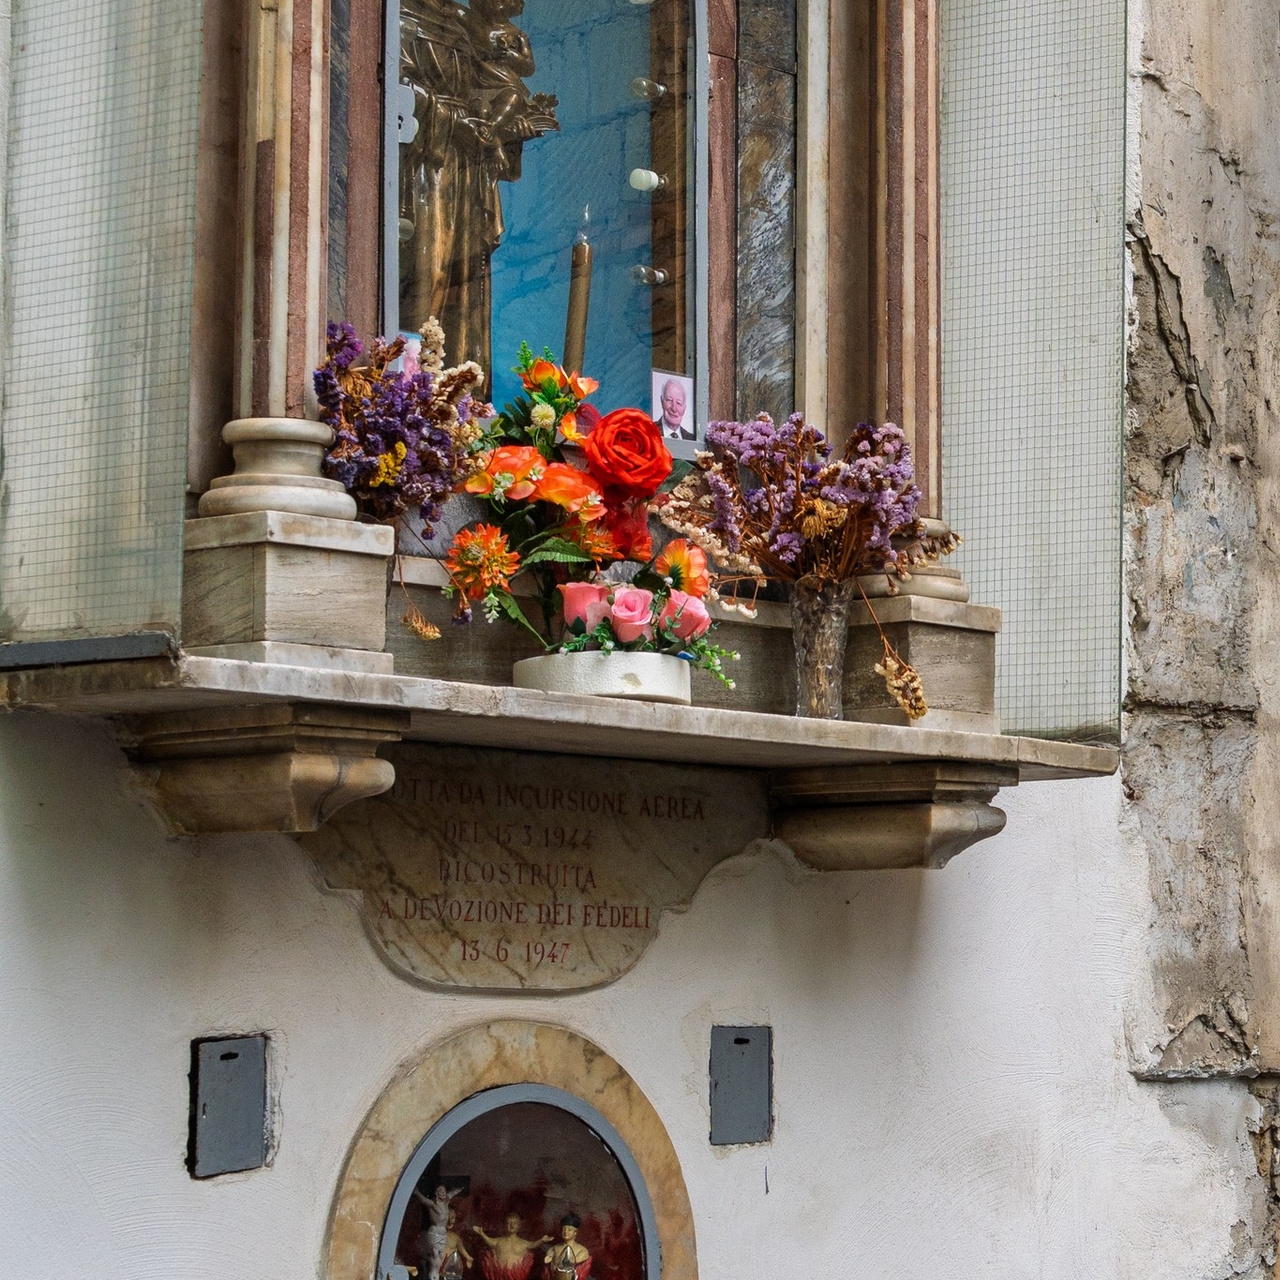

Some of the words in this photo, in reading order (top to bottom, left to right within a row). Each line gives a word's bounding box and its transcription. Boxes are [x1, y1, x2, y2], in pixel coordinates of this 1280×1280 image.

[459, 781, 486, 806] DA
[497, 784, 628, 816] INCURSIONE
[639, 794, 705, 821] AEREA
[443, 820, 485, 844] DEL
[544, 826, 593, 850] 1944
[438, 858, 598, 889] RICOSTRUITA
[379, 897, 394, 920] A
[403, 897, 528, 925] DEVOZIONE
[537, 902, 573, 927] DEI
[582, 904, 651, 929] FEDELI
[460, 939, 481, 962] 13
[496, 936, 509, 963] 6
[525, 940, 571, 964] 1947
